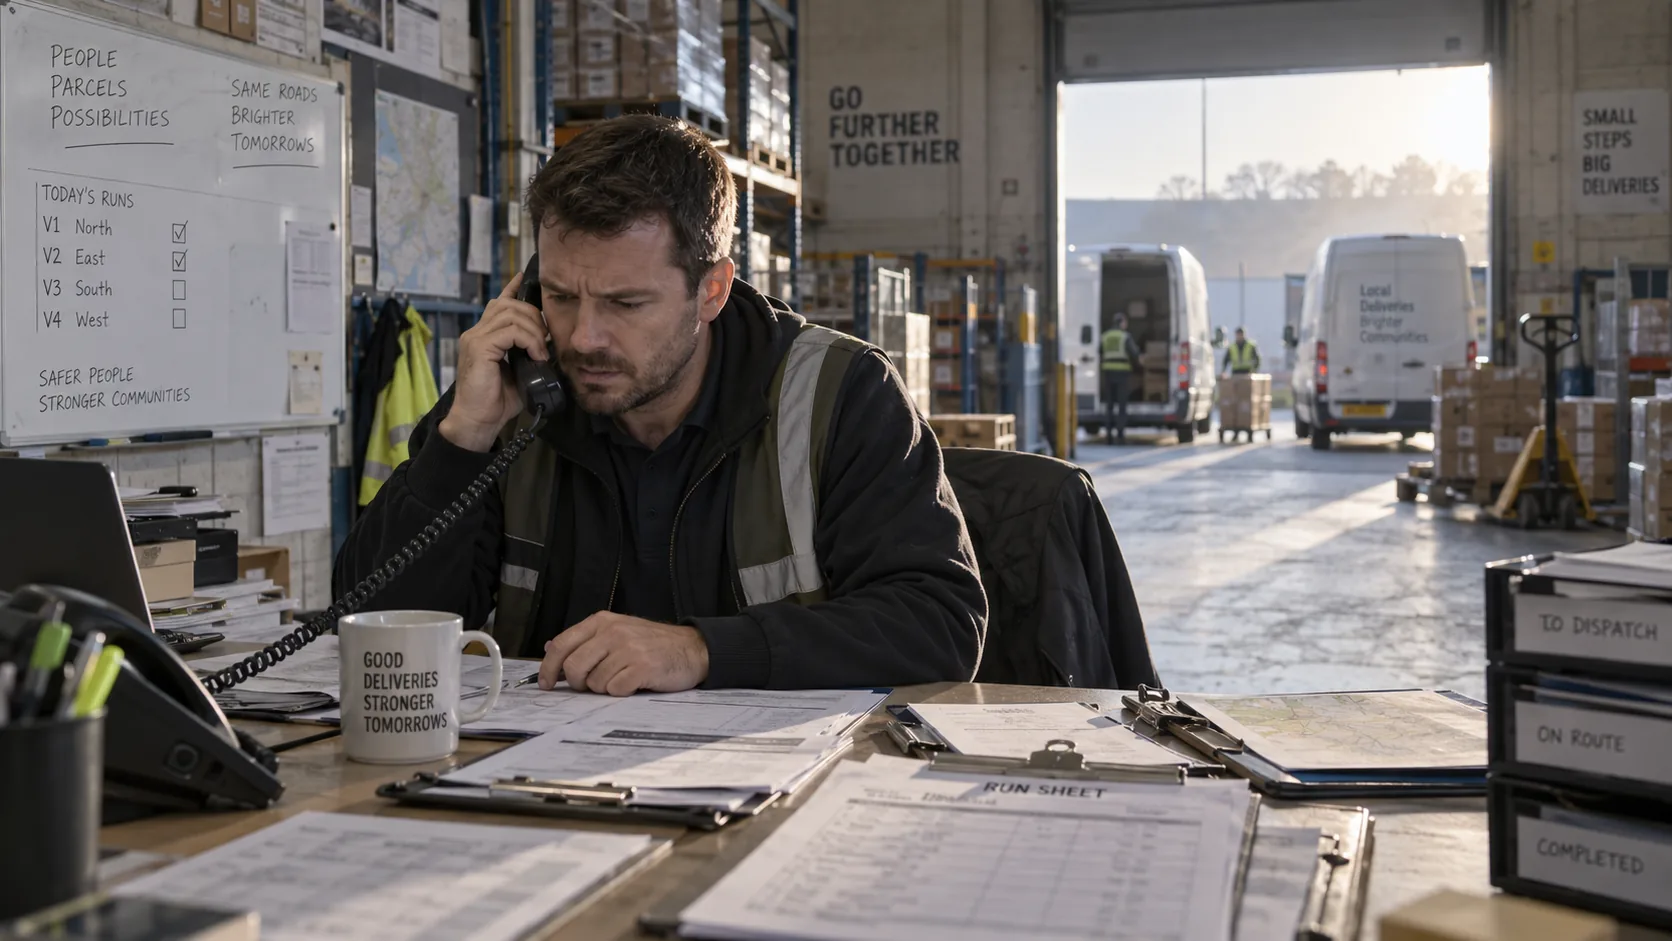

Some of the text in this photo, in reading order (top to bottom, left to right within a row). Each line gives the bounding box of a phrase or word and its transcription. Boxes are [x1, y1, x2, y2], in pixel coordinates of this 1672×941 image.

[51, 44, 117, 68] PEOPLE
[51, 75, 128, 98] PARCELS
[231, 79, 318, 102] SAME ROADS
[829, 85, 863, 111] GO
[51, 105, 170, 129] POSSIBILITIES
[231, 105, 295, 125] BRIGHTER
[829, 110, 939, 138] FURTHER
[1583, 108, 1637, 126] SMALL
[231, 133, 315, 152] TOMORROWS
[1583, 130, 1632, 150] STEPS
[829, 139, 960, 168] TOGETHER
[1583, 154, 1611, 173] BIG
[41, 184, 134, 208] TODAY'S RUNS
[1583, 176, 1660, 196] DELIVERIES
[43, 215, 113, 236] V1 North
[43, 247, 106, 266] V2 East
[43, 279, 113, 297] V3 South
[1360, 284, 1391, 297] Local
[1360, 300, 1414, 312] Deliveries
[43, 311, 109, 329] V4 West
[1360, 316, 1403, 330] Brighter
[1360, 331, 1429, 343] Communities
[39, 367, 134, 387] SAFER PEOPLE
[39, 387, 191, 413] STRONGER COMMUNITIES
[1539, 613, 1658, 641] TO DISPATCH
[364, 651, 403, 668] GOOD
[364, 671, 438, 690] DELIVERIES
[364, 693, 434, 711] STRONGER
[364, 712, 447, 733] TOMORROWS
[1537, 725, 1625, 752] ON ROUTE
[984, 781, 1107, 799] RUN SHEET
[1537, 838, 1644, 874] COMPLETED
